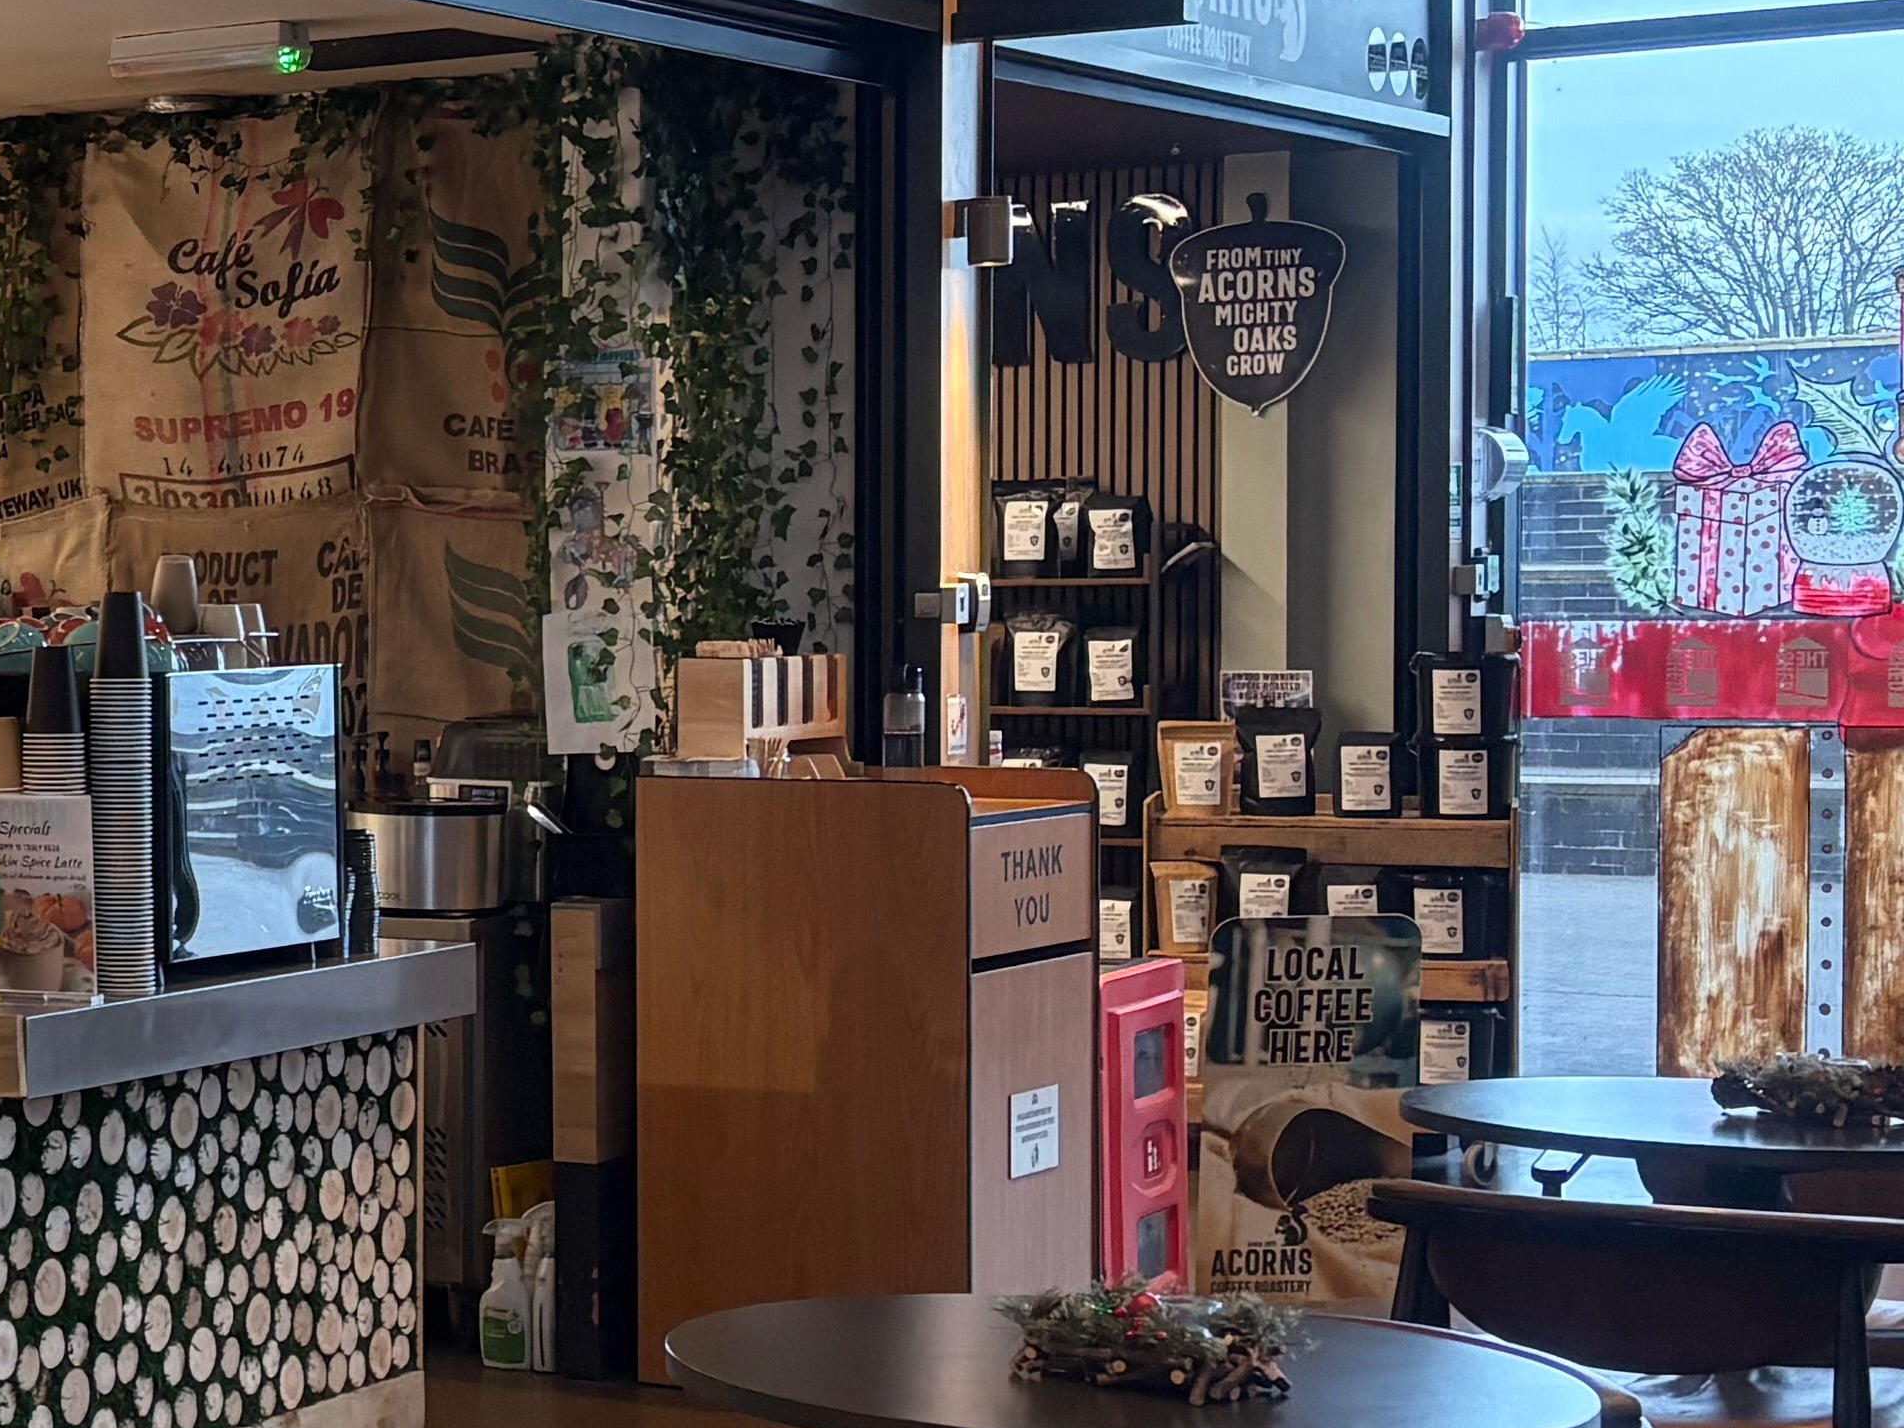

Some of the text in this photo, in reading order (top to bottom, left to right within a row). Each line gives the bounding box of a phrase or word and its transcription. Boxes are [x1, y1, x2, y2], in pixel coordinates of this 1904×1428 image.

[167, 229, 254, 290] Café
[1205, 246, 1302, 272] FROM TINY
[235, 260, 340, 319] Sofía
[1197, 266, 1316, 303] ACORNS
[1214, 300, 1299, 327] MIGHTY
[1232, 324, 1297, 354] OAKS
[1225, 354, 1286, 377] GROW
[134, 387, 356, 445] SUPREMO 19
[162, 456, 193, 478] 14
[58, 478, 83, 499] UK
[332, 573, 364, 613] DE
[0, 821, 51, 839] Specials
[20, 853, 84, 871] Spice Latte
[1000, 843, 1064, 882] THANK
[1014, 894, 1051, 928] YOU
[1266, 946, 1364, 982] LOCAL
[1254, 987, 1373, 1024] COFFEE
[1268, 1029, 1354, 1065] HERE
[1211, 1248, 1313, 1277] ACORNS
[1210, 1279, 1312, 1294] COFFEE ROASTERY
